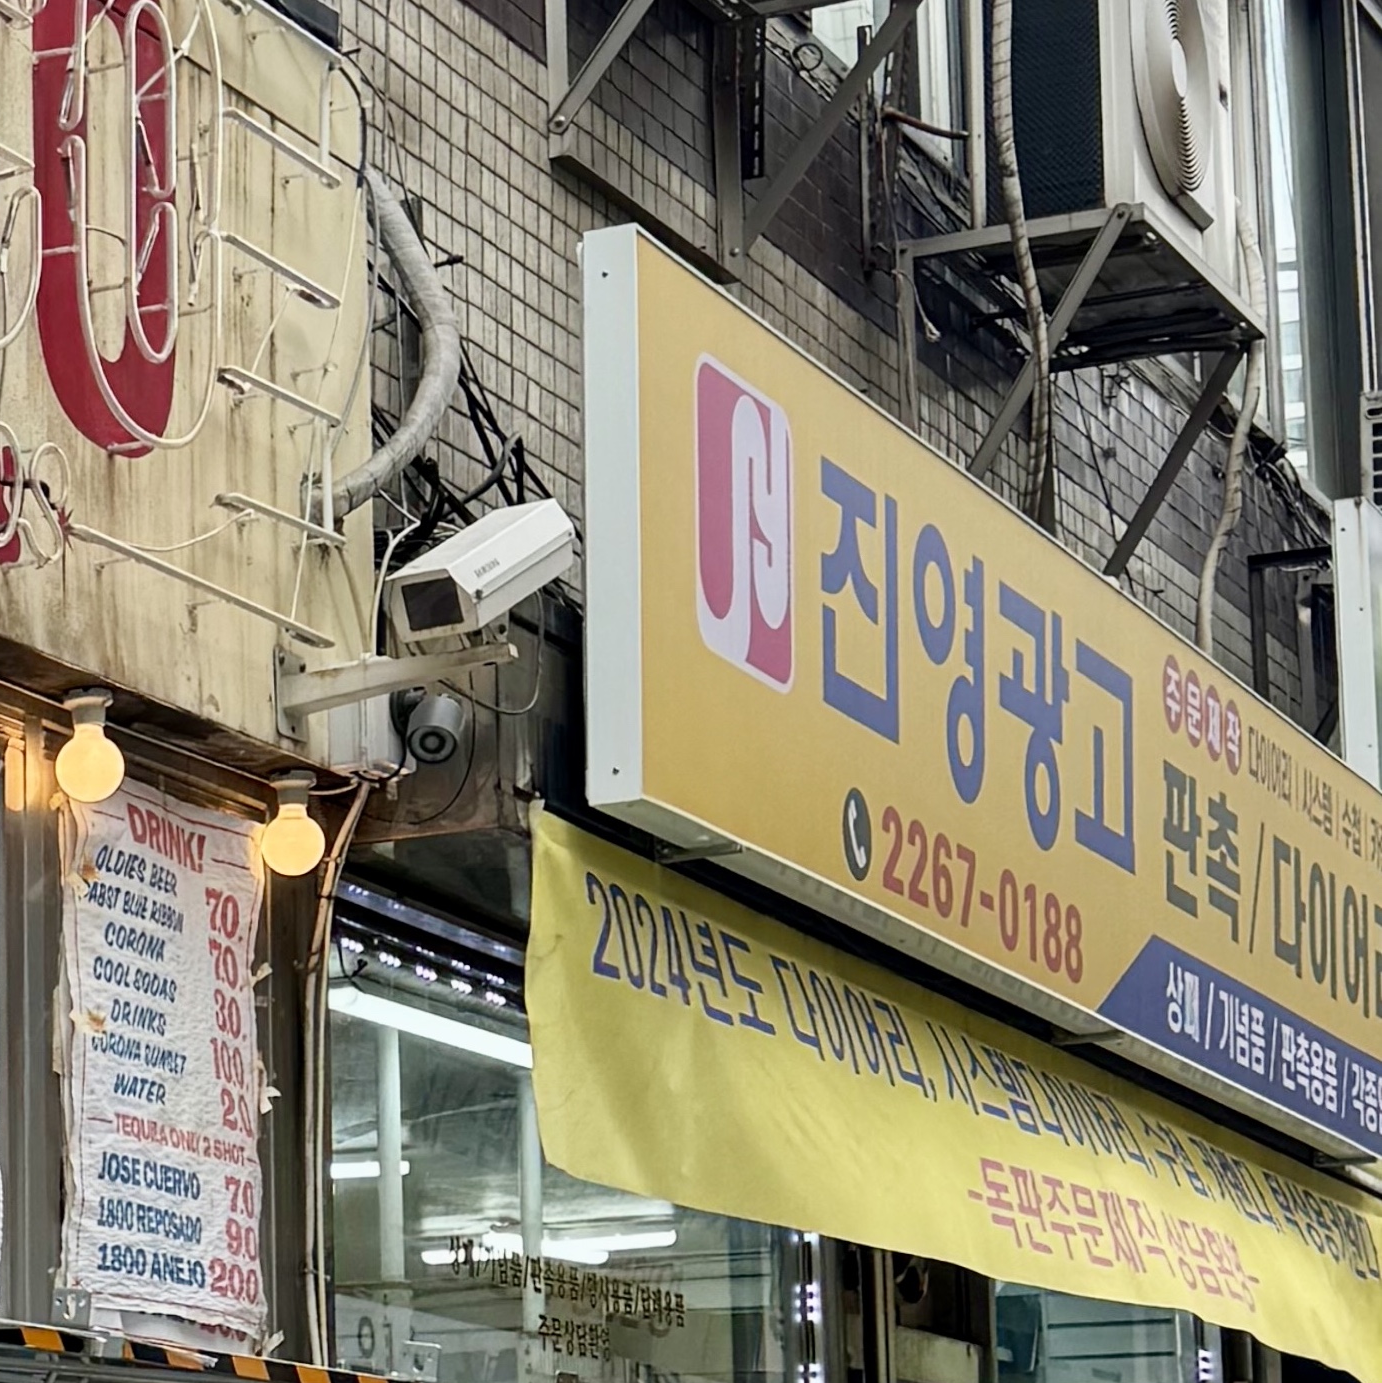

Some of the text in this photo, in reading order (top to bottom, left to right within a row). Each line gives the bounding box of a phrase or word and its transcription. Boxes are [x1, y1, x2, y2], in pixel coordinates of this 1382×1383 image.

[821, 455, 1135, 874] 진영광고
[1163, 654, 1242, 775] 주문제작
[1248, 725, 1291, 807] 다이어리
[127, 802, 207, 874] DRINK!
[95, 845, 177, 897] OLDIES BEER
[123, 890, 148, 920] BLUE
[150, 898, 184, 934] RIBBON
[882, 807, 1084, 985] 2267-0188
[105, 921, 165, 963] CORONA
[585, 871, 776, 1036] 2024년도
[93, 956, 177, 1003] COOL SODAS
[111, 998, 166, 1036] DRINKS
[1166, 961, 1337, 1113] 상패 기념품 판촉용품
[91, 1032, 187, 1075] CORONA SUNSET
[114, 1073, 166, 1105] WATER
[98, 1151, 141, 1186] JOSE
[143, 1163, 201, 1201] CUERVO
[212, 1141, 245, 1166] SHOT
[97, 1196, 135, 1231] 1800
[136, 1203, 202, 1245] REPOSADO
[97, 1242, 147, 1277] 1800
[150, 1249, 206, 1289] ANEJO
